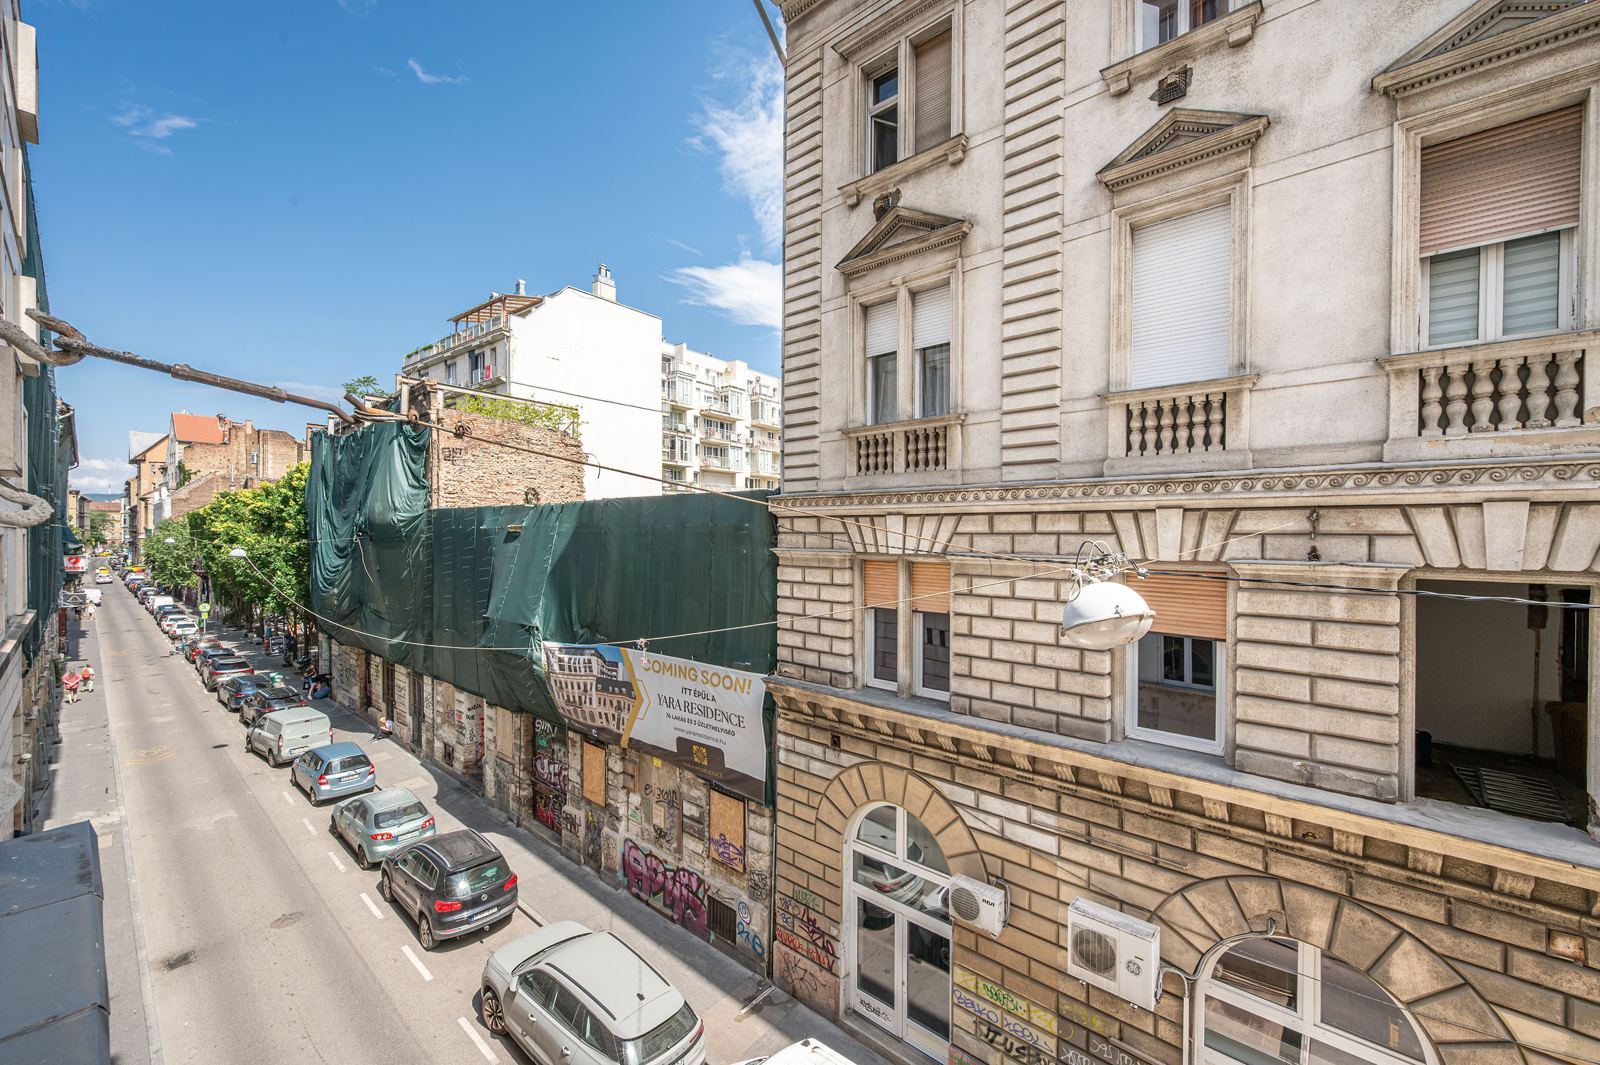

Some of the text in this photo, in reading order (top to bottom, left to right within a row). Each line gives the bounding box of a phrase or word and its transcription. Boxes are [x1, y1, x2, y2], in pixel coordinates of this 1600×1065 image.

[642, 658, 752, 695] COMING SOON!
[681, 687, 717, 703] ITT ÉPÜL A
[657, 693, 746, 729] YARA RESIDENCE
[671, 714, 686, 723] LAKÁS
[687, 717, 693, 725] ÉS
[697, 719, 736, 737] ÜZLETHELYISÉG
